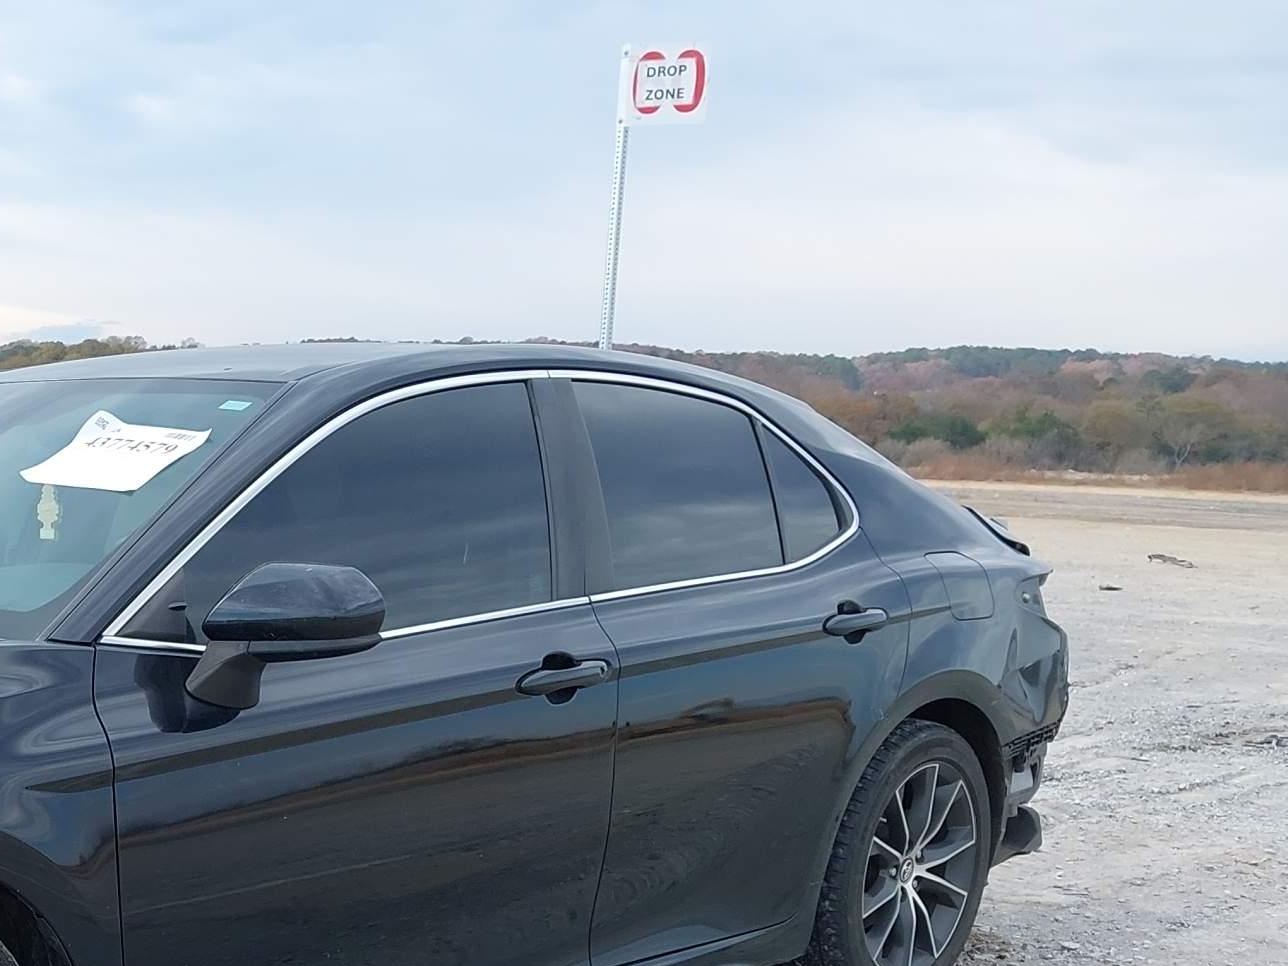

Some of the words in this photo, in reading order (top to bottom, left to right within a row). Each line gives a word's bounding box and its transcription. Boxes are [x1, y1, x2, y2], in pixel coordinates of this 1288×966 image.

[646, 64, 688, 78] DROP
[644, 87, 686, 101] ZONE
[84, 436, 179, 455] 43774579
